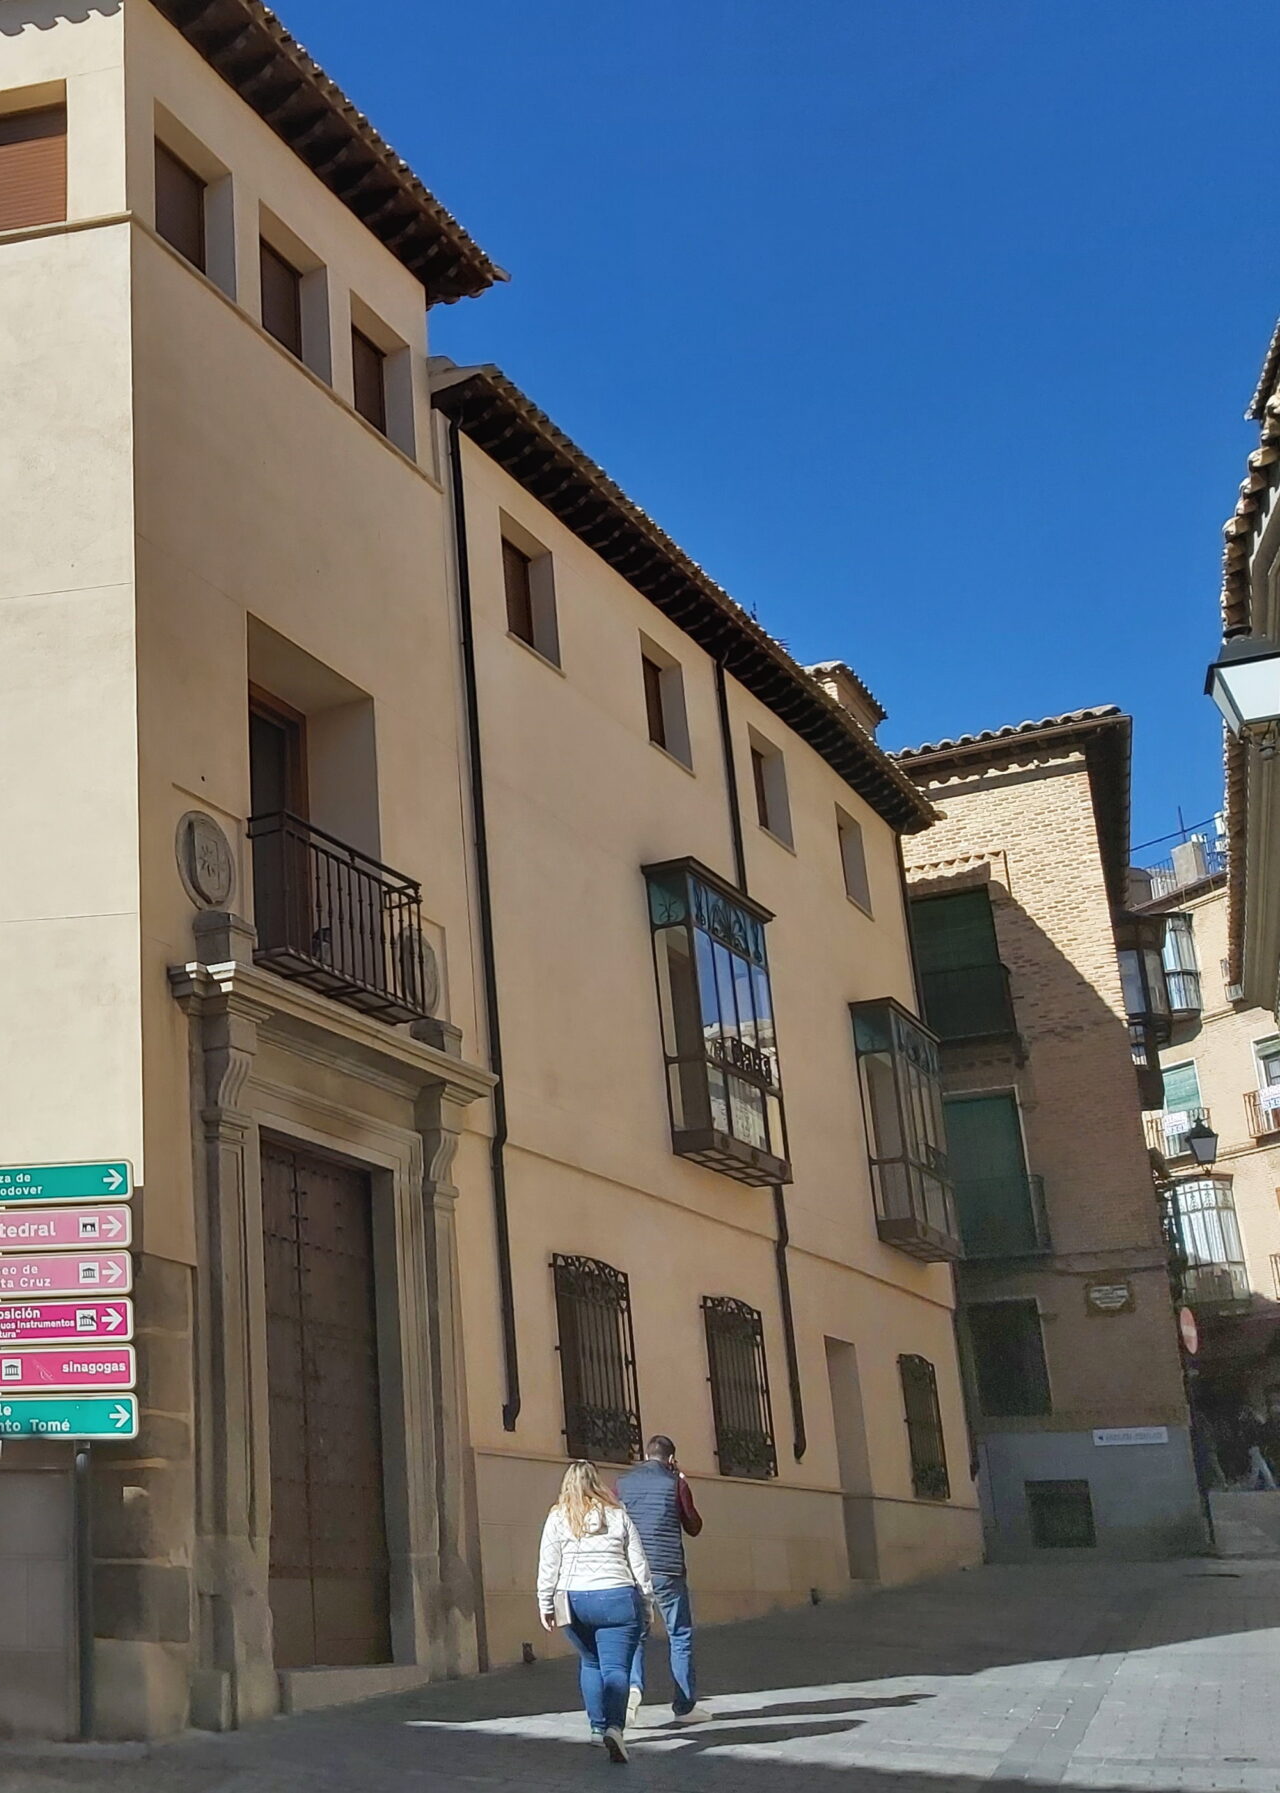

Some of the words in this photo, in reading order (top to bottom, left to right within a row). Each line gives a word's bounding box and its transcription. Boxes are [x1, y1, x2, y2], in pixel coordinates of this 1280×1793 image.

[16, 1173, 31, 1183] de
[22, 1264, 38, 1274] de
[20, 1277, 51, 1288] Cruz
[17, 1319, 75, 1329] Instrumentos
[62, 1360, 126, 1374] sinagogas
[29, 1418, 71, 1432] Tomé
